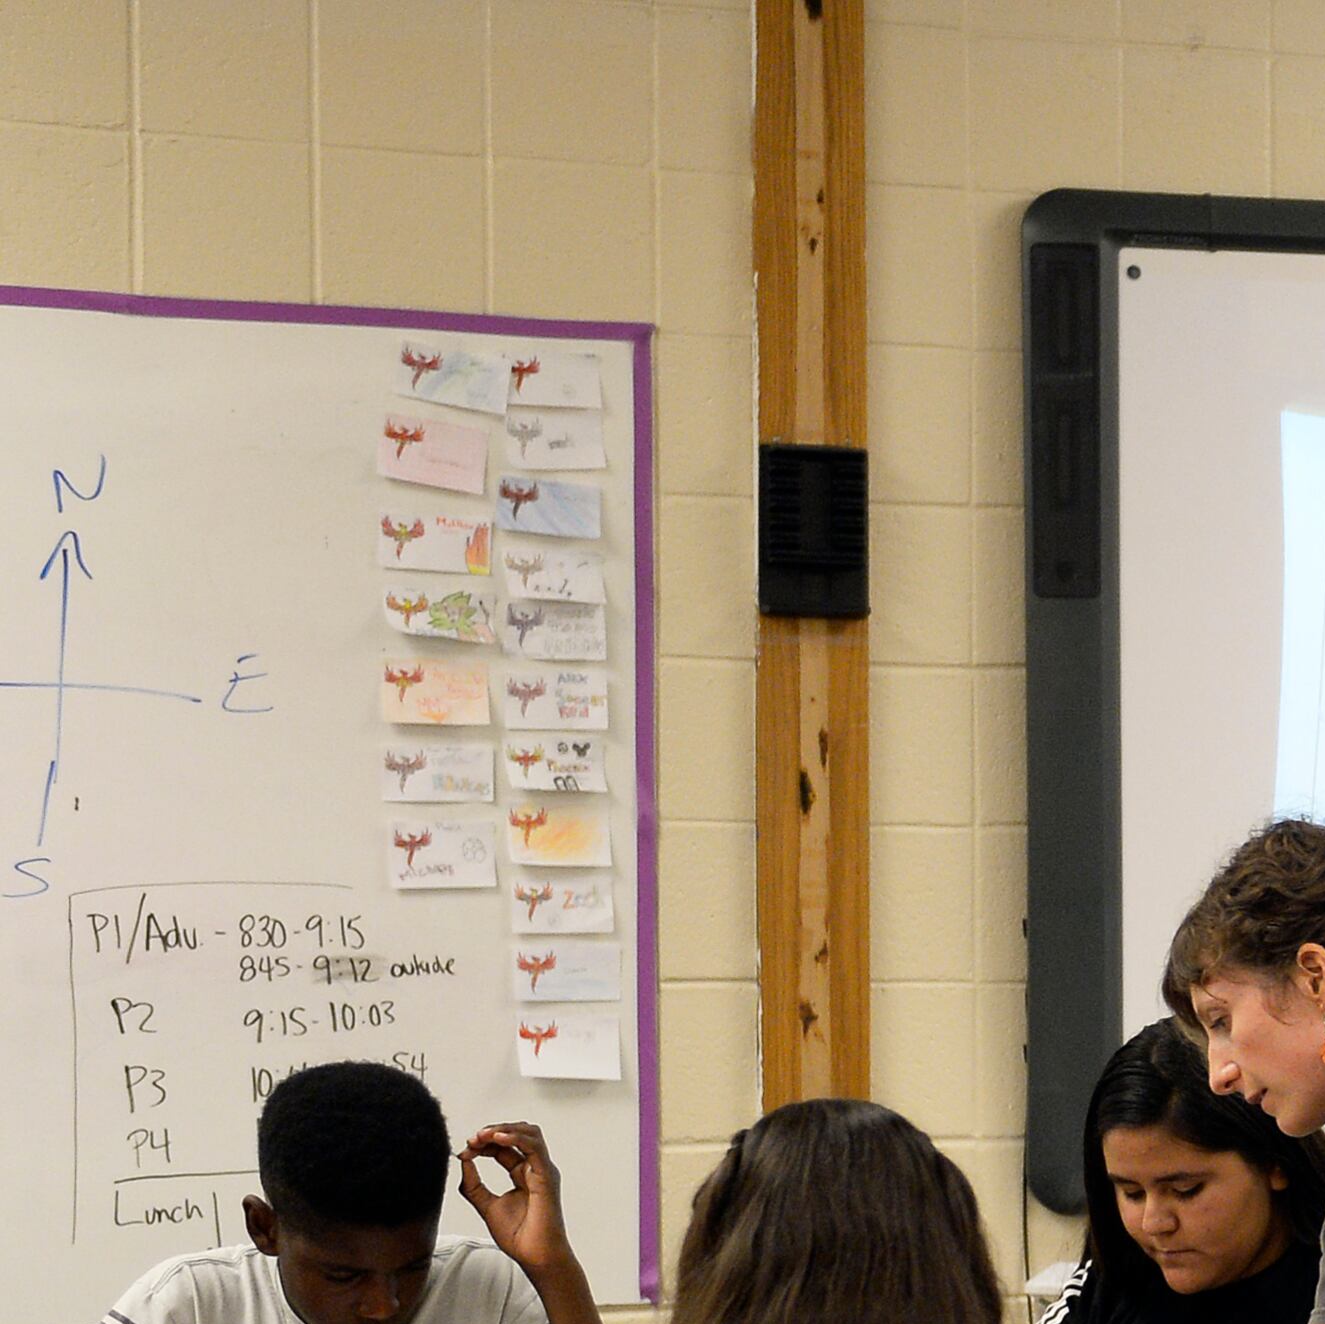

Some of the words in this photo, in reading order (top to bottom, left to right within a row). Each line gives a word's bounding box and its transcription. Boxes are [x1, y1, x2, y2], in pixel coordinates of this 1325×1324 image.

[53, 455, 105, 512] N
[222, 654, 273, 713] E
[2, 857, 52, 897] S
[111, 997, 157, 1034] P2
[125, 1065, 166, 1114] P3
[127, 1128, 172, 1167] P4
[114, 1190, 204, 1227] Lunch
